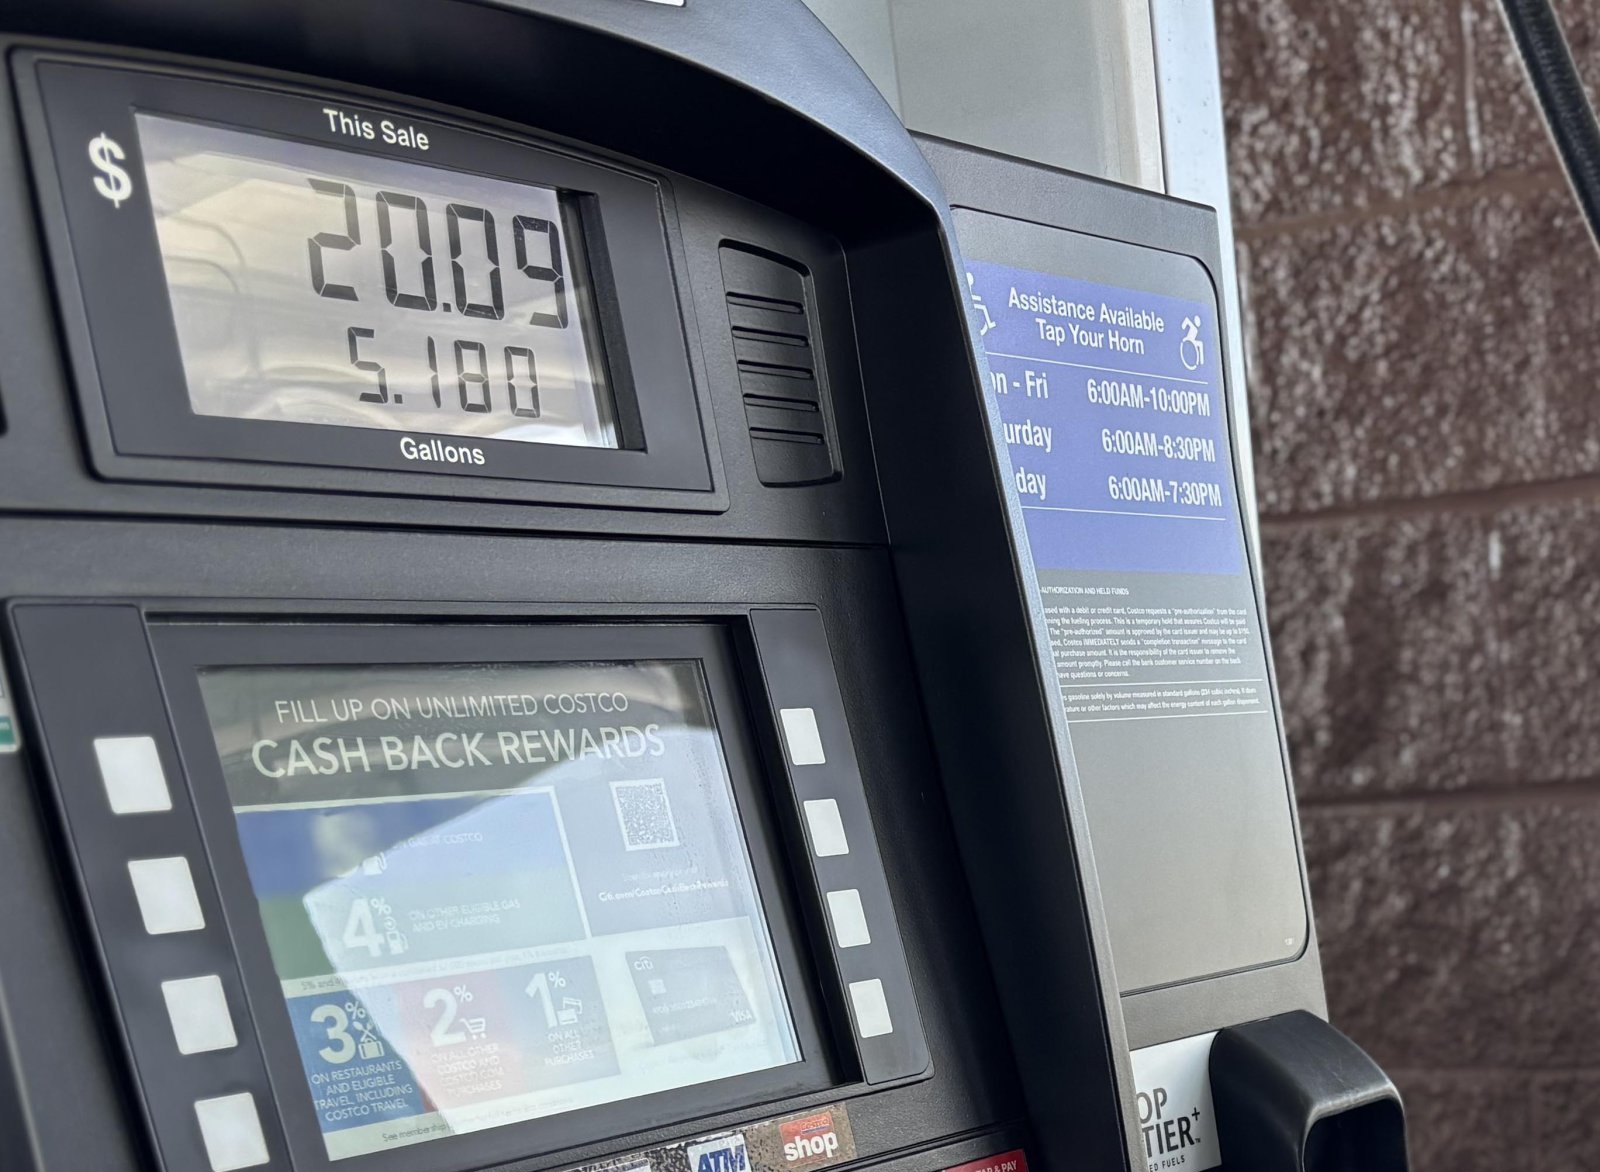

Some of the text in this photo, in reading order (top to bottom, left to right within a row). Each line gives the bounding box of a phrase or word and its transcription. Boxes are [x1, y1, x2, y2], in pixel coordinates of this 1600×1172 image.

[323, 109, 430, 150] This Sale
[88, 132, 133, 208] $
[306, 177, 569, 329] 20.09
[1008, 287, 1164, 333] Assistance Available
[1035, 318, 1144, 354] Tap Your Horn
[347, 326, 540, 419] 5.180
[1025, 370, 1048, 399] Fri
[1087, 378, 1210, 417] 6:00AM-10:00PM
[400, 437, 485, 466] Gallons
[1003, 418, 1216, 462] urday 6:00AM-8:30PM
[1108, 475, 1222, 507] 6:00AM-7:30PM
[275, 691, 629, 724] FILL UP ON UNLIMITED COSTCO
[251, 724, 665, 778] CASH BACK REWARDS
[311, 1060, 402, 1086] ON RESTAURANTS
[326, 1074, 395, 1096] AND ELIGIBLE
[324, 1098, 409, 1122] COSTCO TRAVEL
[356, 1084, 413, 1106] INCLUDING
[1136, 1087, 1168, 1124] OP
[783, 1131, 839, 1162] shop
[1161, 1154, 1186, 1170] FUELS
